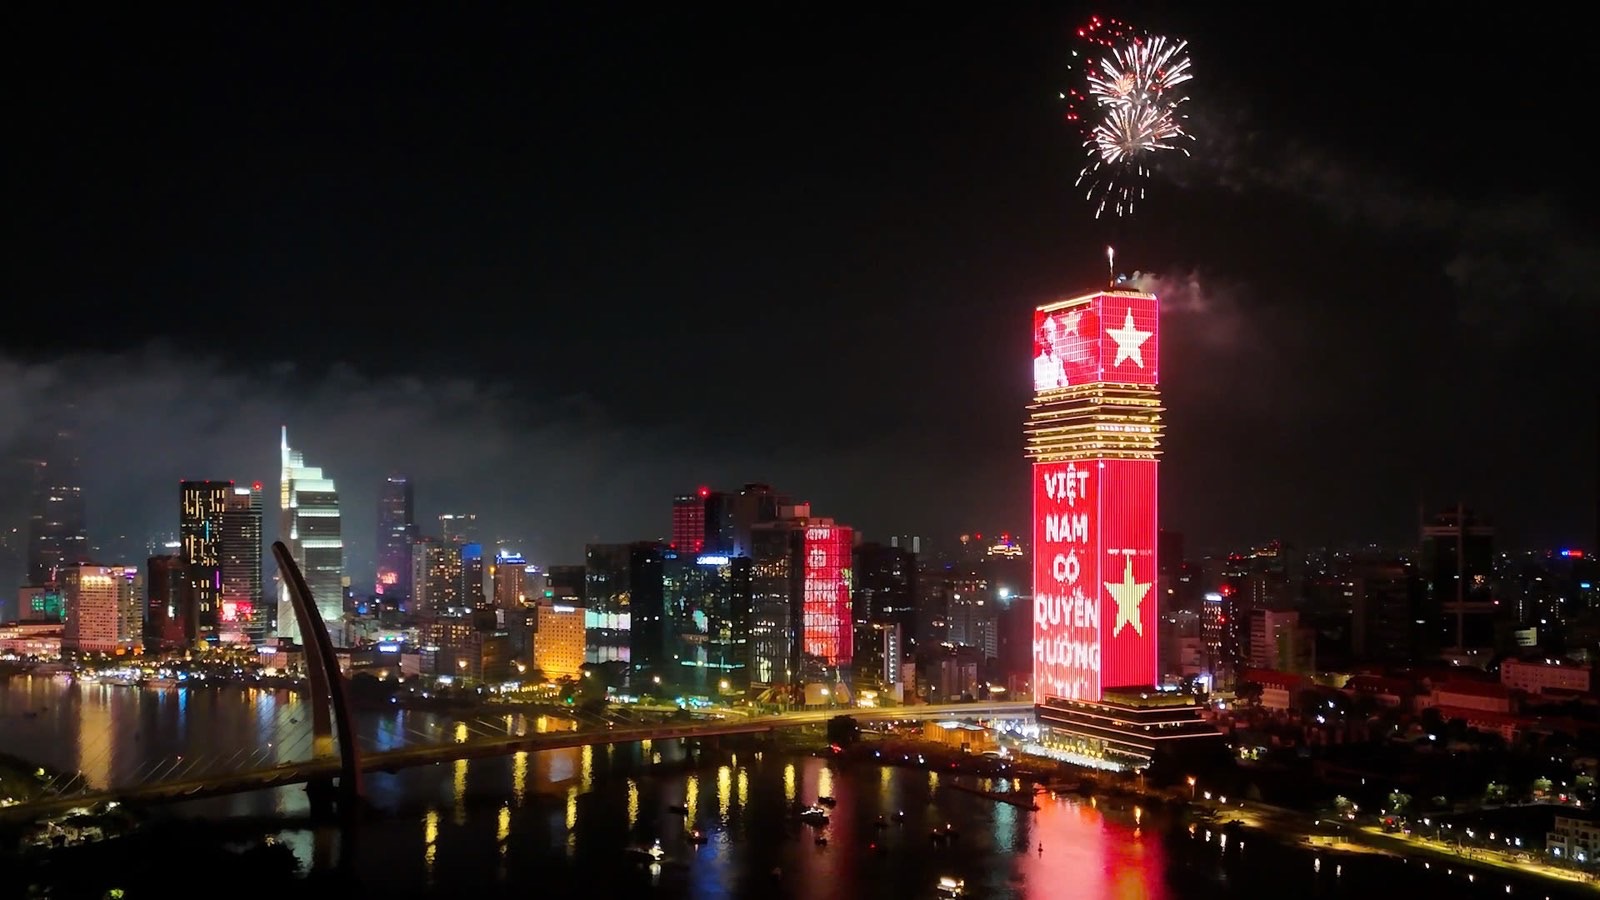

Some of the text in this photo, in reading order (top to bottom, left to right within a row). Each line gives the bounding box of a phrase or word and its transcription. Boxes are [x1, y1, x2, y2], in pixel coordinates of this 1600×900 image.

[1044, 461, 1090, 507] VIỆT
[1046, 513, 1089, 544] NAM
[1036, 586, 1098, 631] QUYỀN
